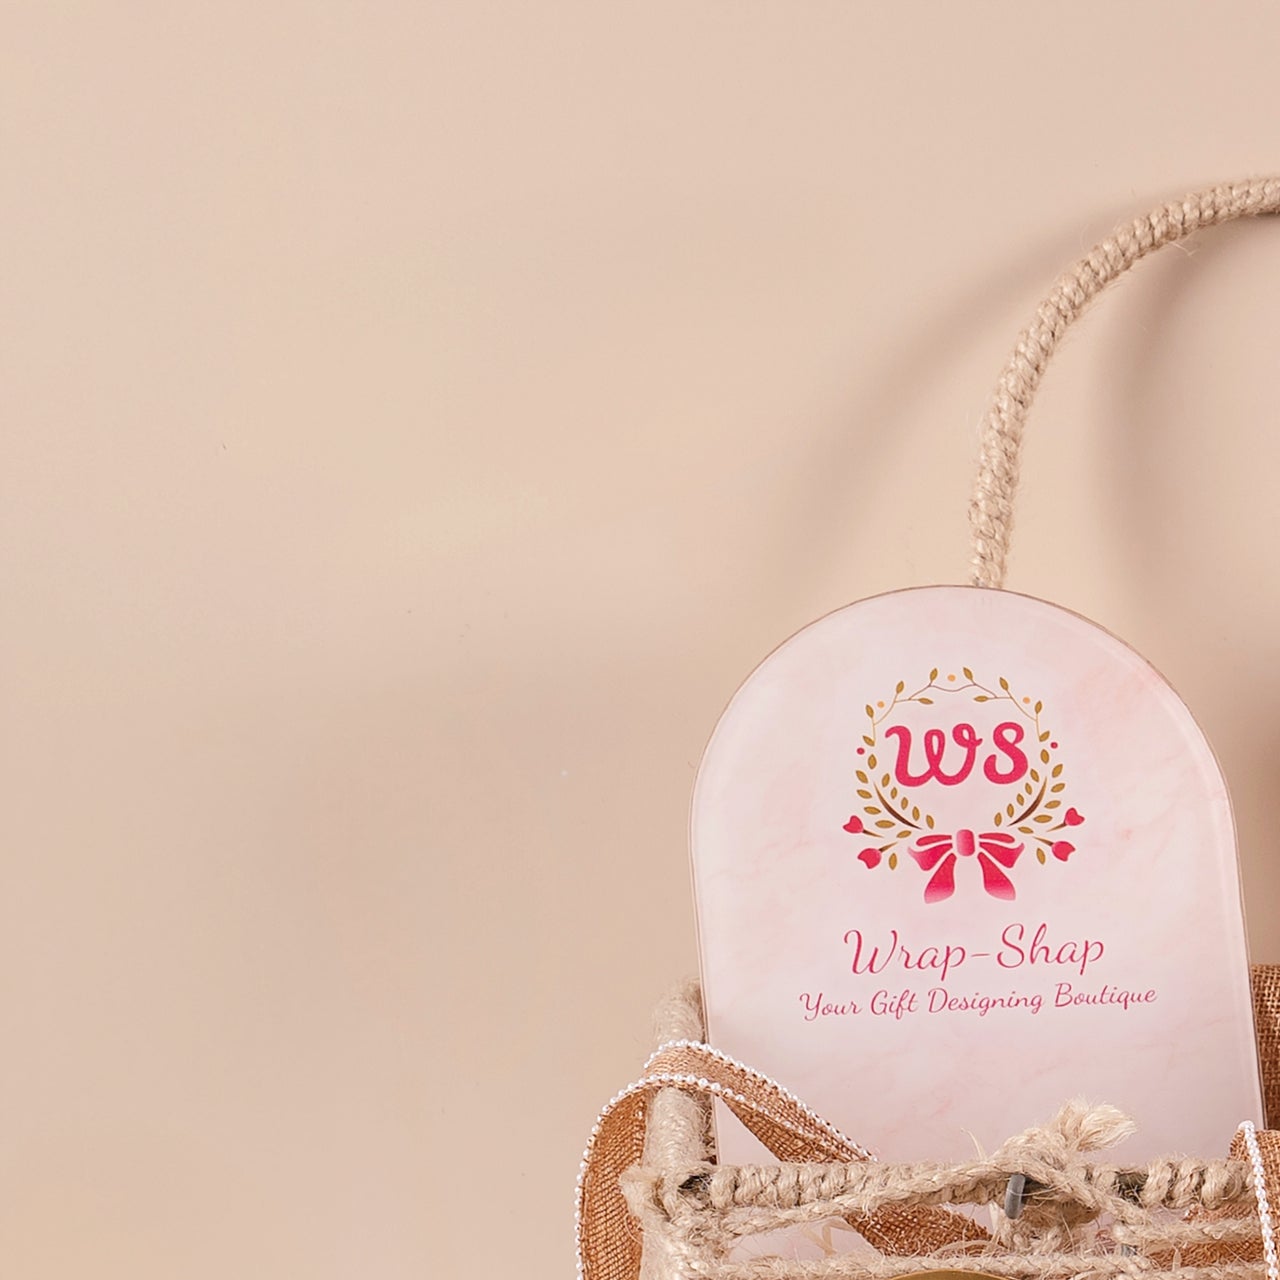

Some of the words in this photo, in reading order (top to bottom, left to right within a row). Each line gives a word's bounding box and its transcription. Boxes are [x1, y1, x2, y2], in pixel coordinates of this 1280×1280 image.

[885, 721, 1029, 787] WS
[843, 922, 1105, 982] Wrap-Shap
[799, 992, 863, 1022] Your
[869, 987, 919, 1020] Gift
[927, 983, 1043, 1016] Designing
[1053, 982, 1157, 1010] Boutique
